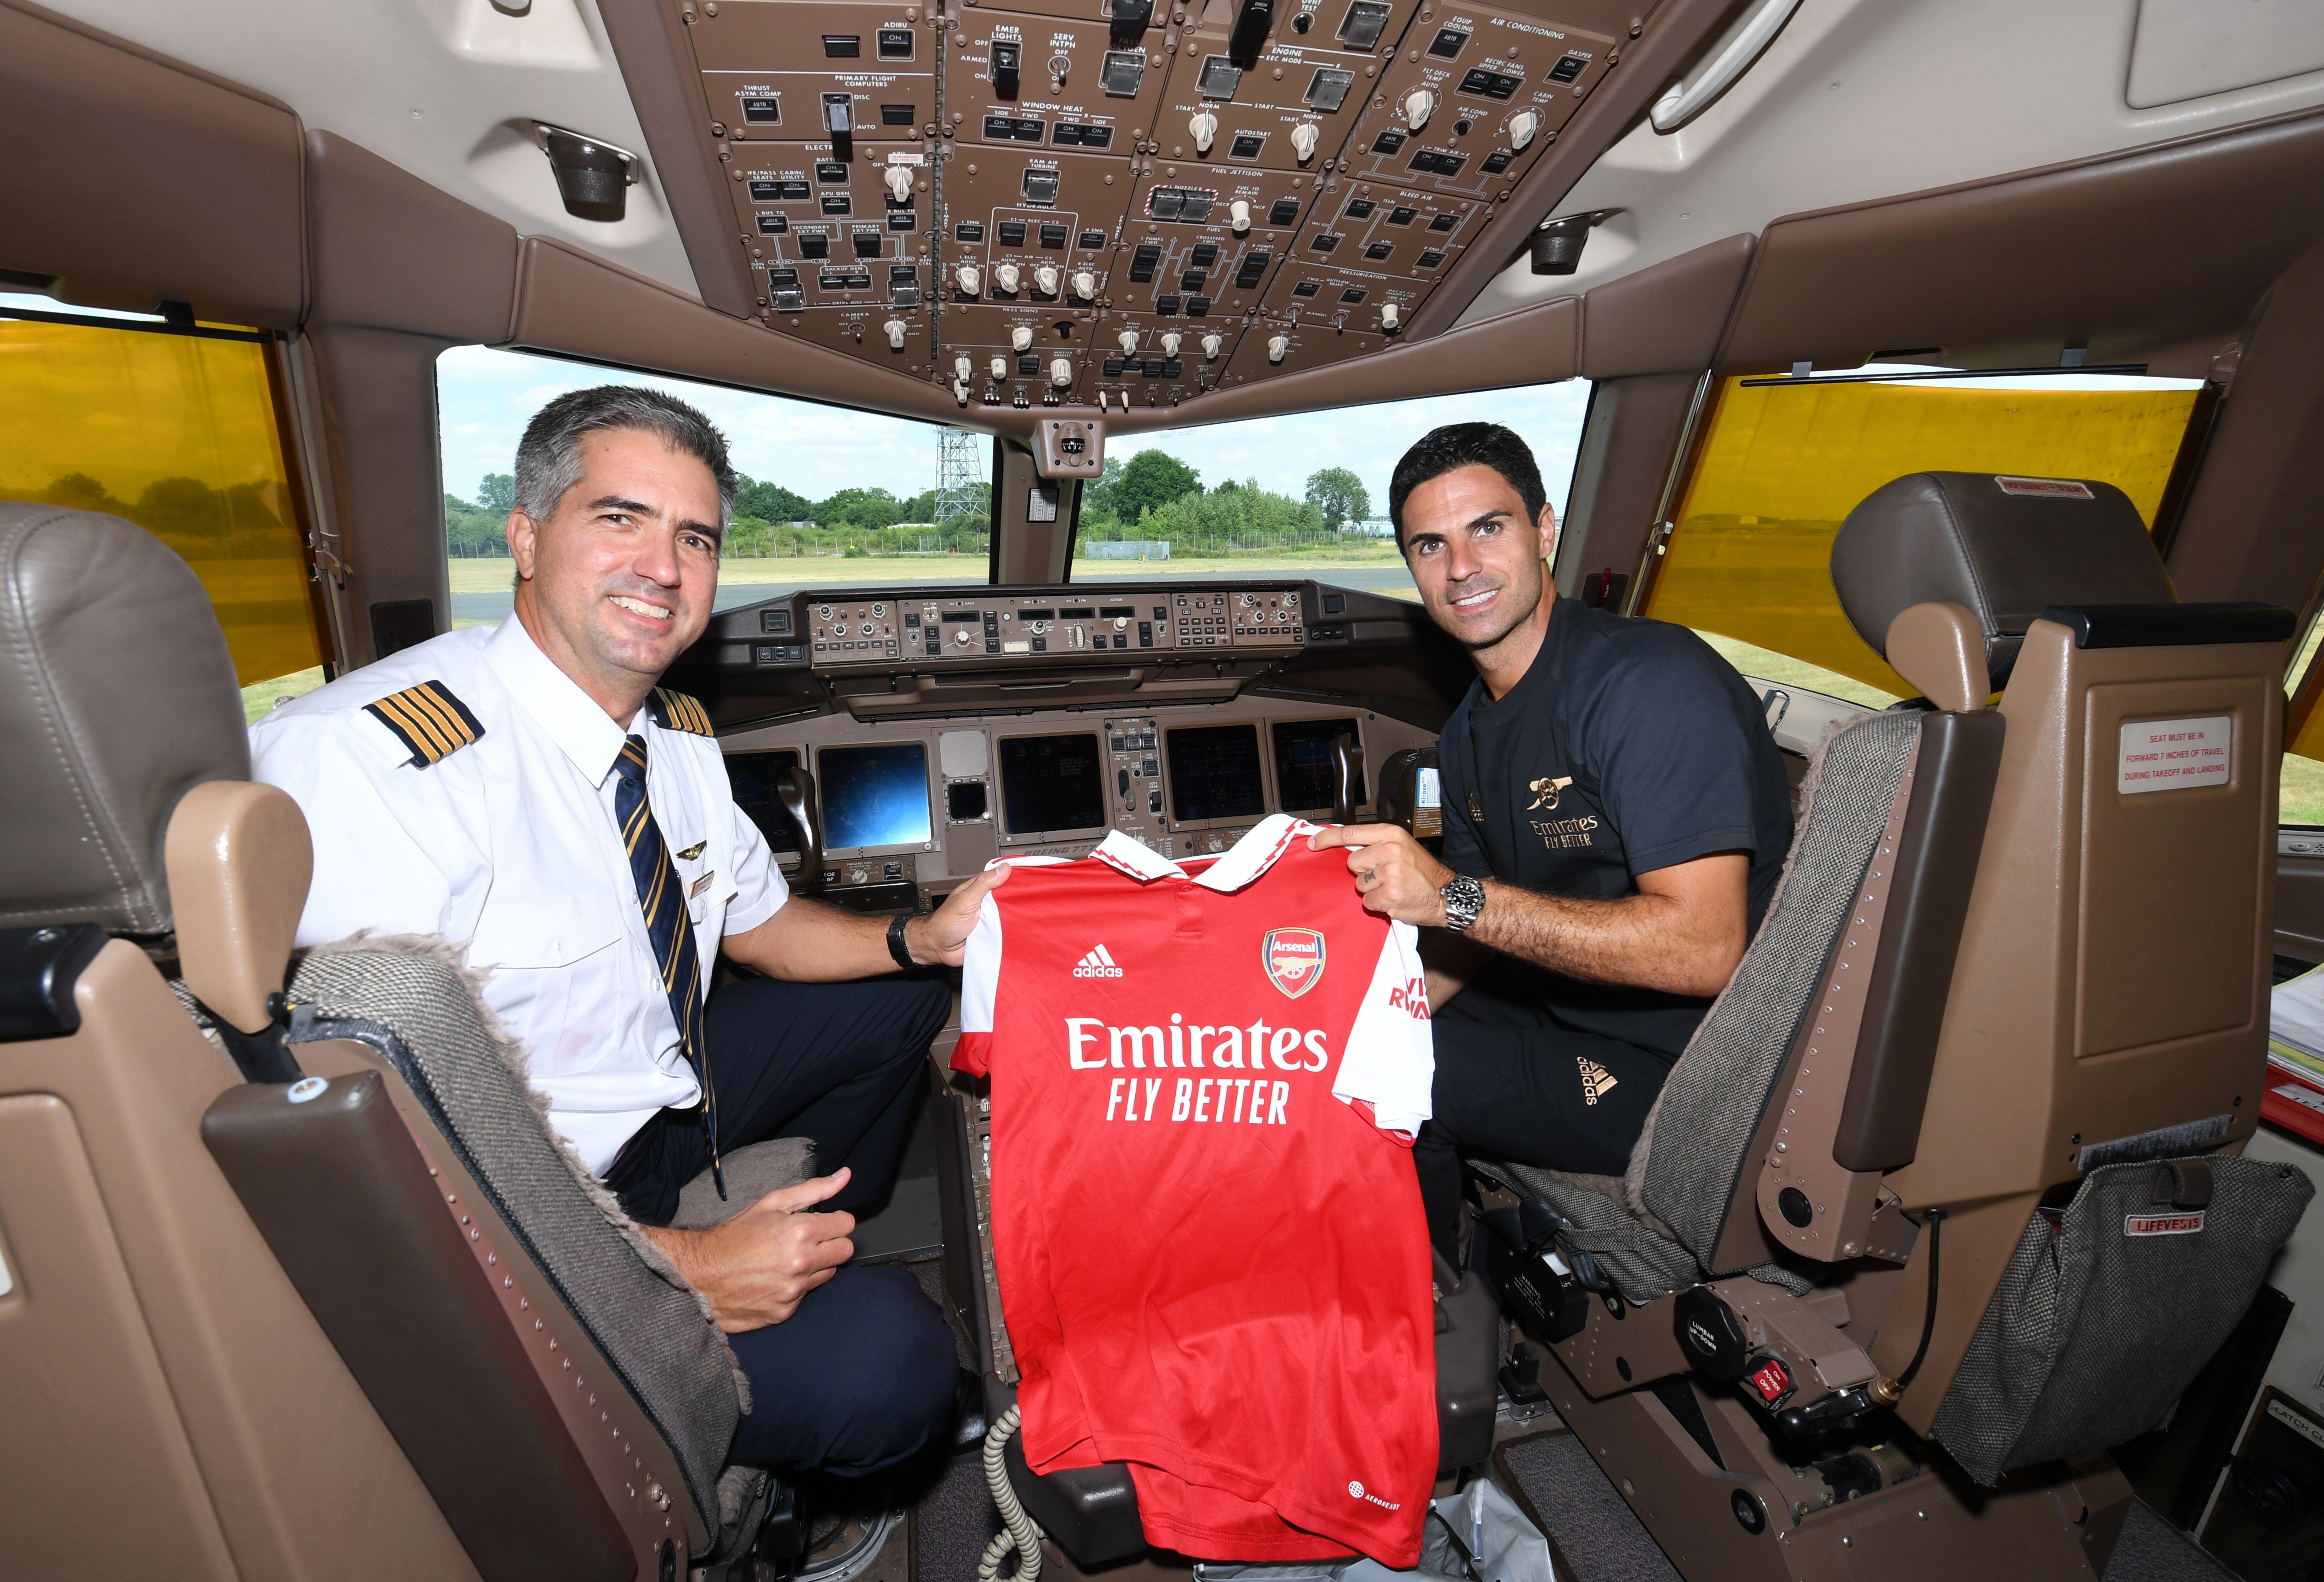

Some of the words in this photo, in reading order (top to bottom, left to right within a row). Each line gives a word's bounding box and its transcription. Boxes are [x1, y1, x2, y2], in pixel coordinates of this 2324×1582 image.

[996, 25, 1019, 33] EMER
[1444, 21, 1474, 32] COOLING
[1490, 18, 1504, 26] AIR
[1507, 21, 1565, 40] CONDITIONING
[992, 32, 1022, 41] LIGHTS
[1050, 40, 1075, 48] INTPH
[1272, 48, 1302, 57] ENGINE
[1568, 49, 1592, 59] GASPER
[1485, 58, 1506, 66] RECIRC
[1434, 70, 1451, 78] DECK
[1503, 68, 1525, 77] LOWER
[1534, 91, 1554, 100] CABIN
[1022, 101, 1060, 110] WINDOW
[1339, 270, 1387, 280] PRESSURIZATION
[2126, 753, 2158, 763] FORWARD
[2166, 751, 2188, 759] INCHES
[2125, 771, 2150, 780] DURING
[2152, 768, 2181, 778] TAKEOFF
[2197, 764, 2225, 773] LANDING
[1530, 815, 1598, 835] Emirates
[1544, 836, 1559, 849] FLY
[1562, 833, 1592, 848] BETTER
[1024, 847, 1070, 855] BOEING
[1273, 941, 1316, 952] Arsenal
[1073, 965, 1123, 978] adidas
[1064, 1013, 1328, 1072] Emirates
[1577, 1057, 1597, 1105] adidas
[1106, 1078, 1161, 1122] FLY
[1172, 1079, 1290, 1125] BETTER
[2137, 1217, 2199, 1231] LIFEVESTS
[1522, 1274, 1541, 1299] WARNING
[1692, 1321, 1714, 1341] LUMBAR
[1690, 1326, 1716, 1351] UP-DOWN
[1763, 1369, 1781, 1391] POWER
[1773, 1370, 1781, 1380] ON
[1759, 1379, 1771, 1391] OFF
[2275, 1407, 2309, 1431] LATCH
[2312, 1431, 2324, 1443] CL
[1365, 1494, 1400, 1510] AEROREADY
